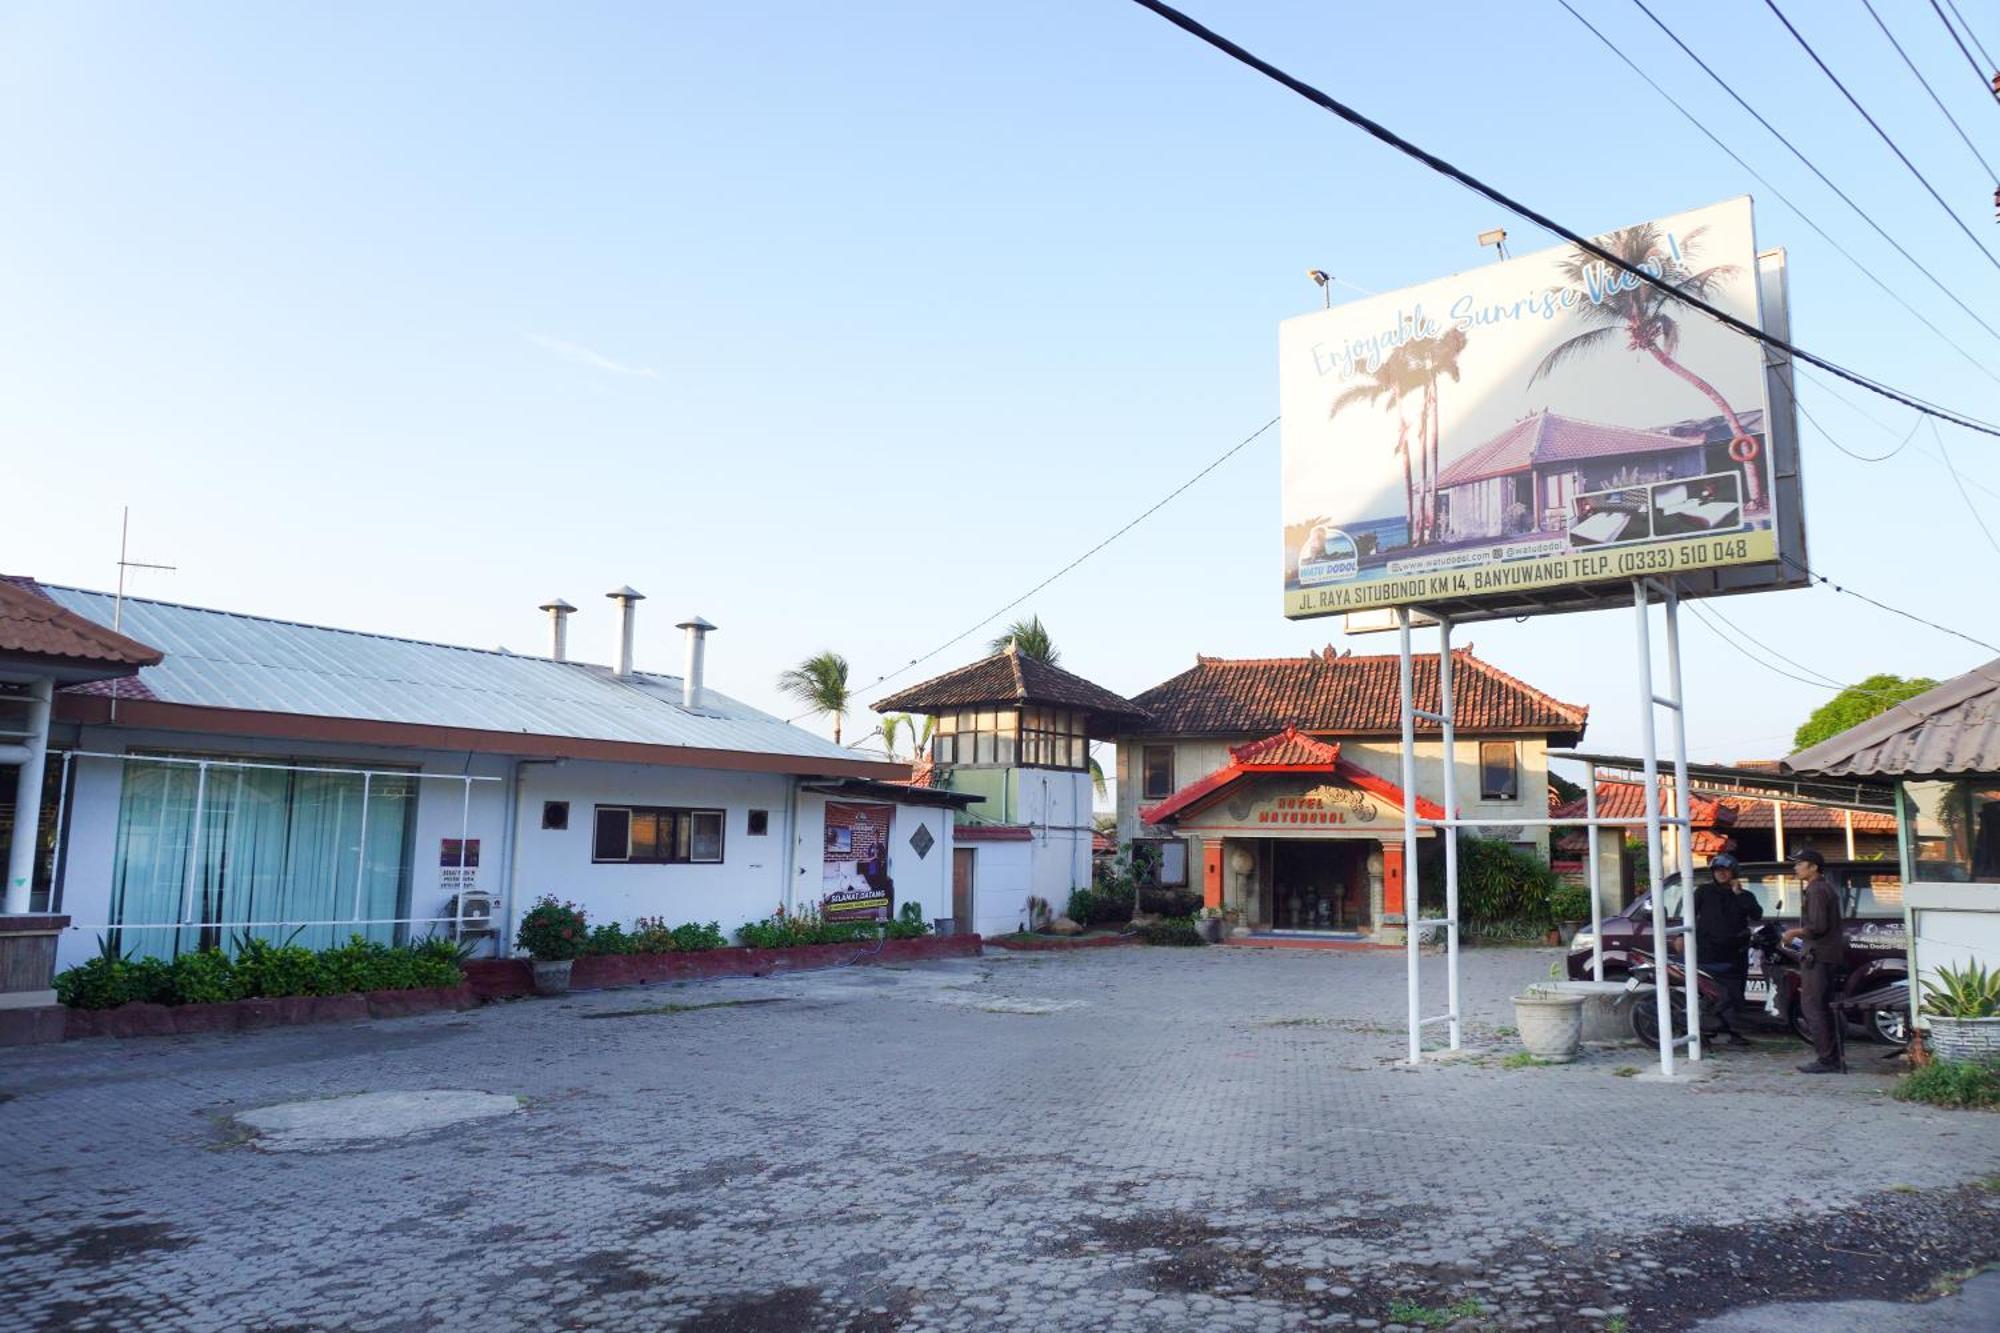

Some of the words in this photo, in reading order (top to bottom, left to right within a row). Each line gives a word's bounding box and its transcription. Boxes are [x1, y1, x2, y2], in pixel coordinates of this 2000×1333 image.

[1312, 303, 1441, 377] Enjoyable
[1450, 287, 1581, 331] Sunrise
[1506, 541, 1563, 559] @watudodol
[1299, 594, 1316, 609] JL.
[1320, 589, 1351, 608] RAYA
[1355, 580, 1425, 603] SITUBONDO
[1430, 576, 1448, 594] KM
[1453, 574, 1470, 591] 14,
[1474, 561, 1568, 589] BANYUWANGI
[1573, 556, 1613, 577] TELP.
[1618, 548, 1674, 574] (0333)
[1680, 545, 1707, 565] 510
[1714, 539, 1747, 561] 048
[1300, 566, 1326, 578] WATU
[1327, 562, 1356, 574] DODOL
[1278, 798, 1324, 810] HOTEL
